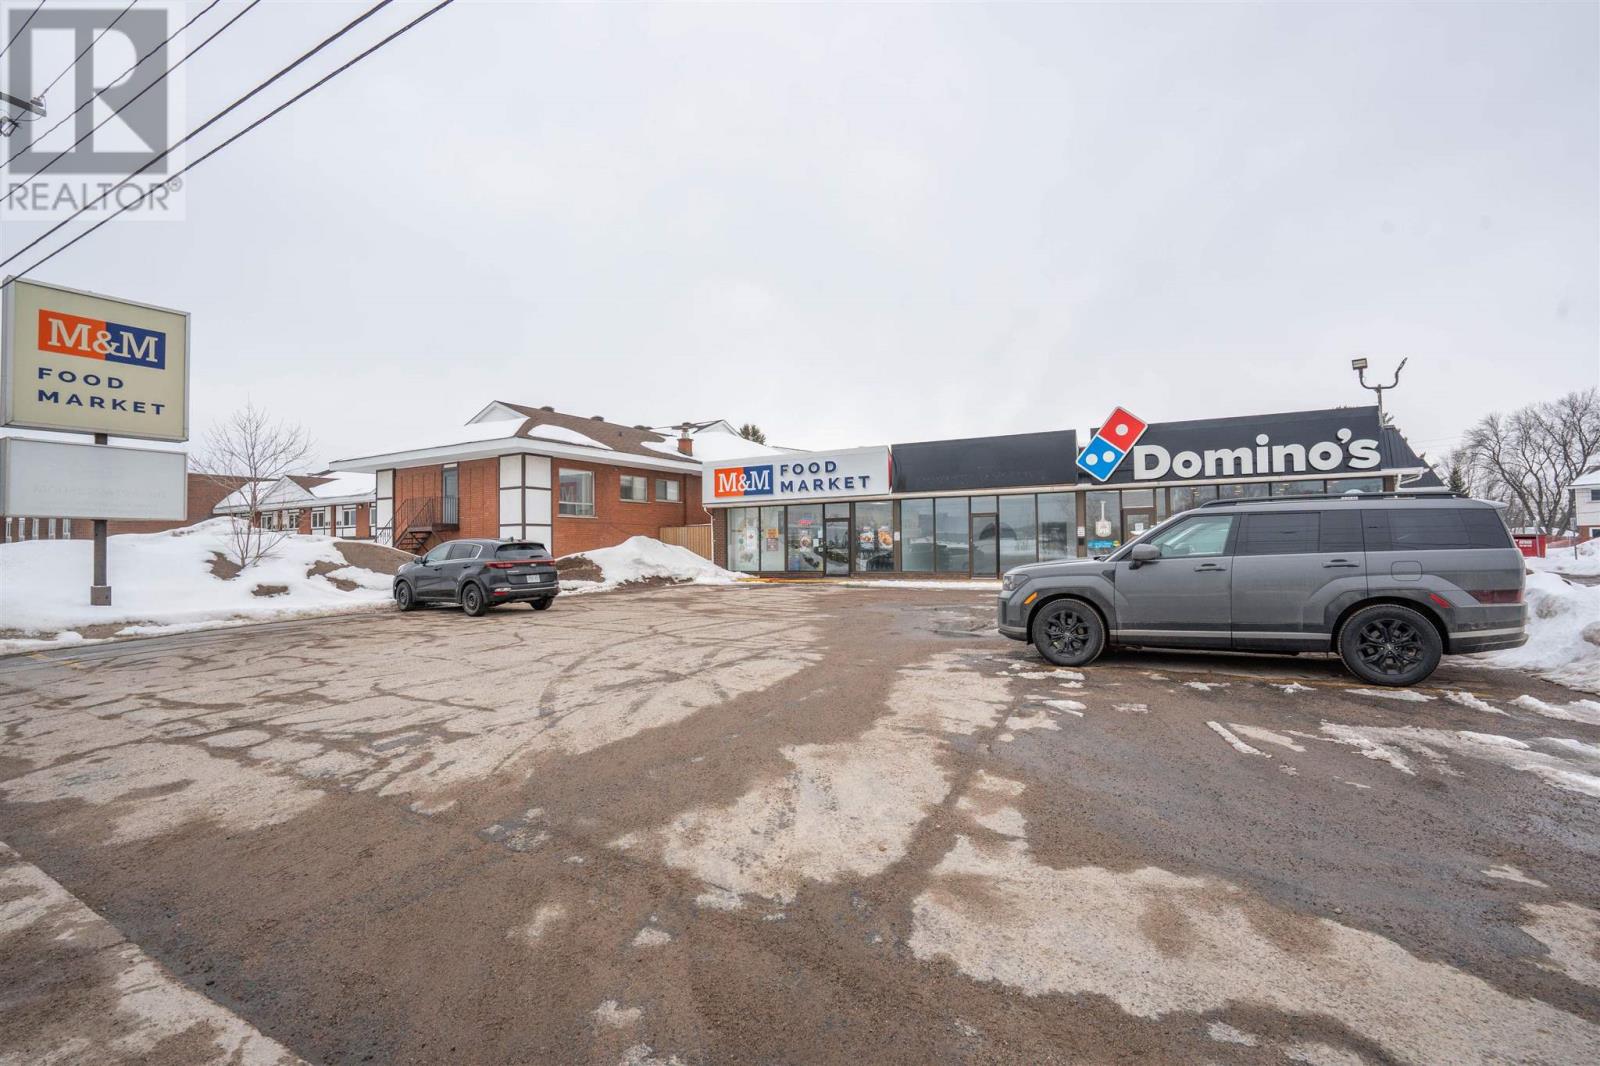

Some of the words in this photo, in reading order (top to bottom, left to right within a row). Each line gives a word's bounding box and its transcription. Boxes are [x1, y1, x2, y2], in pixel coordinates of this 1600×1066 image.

[47, 317, 159, 363] M&M
[38, 367, 124, 389] FOOD
[38, 390, 166, 415] MARKET
[1133, 428, 1381, 480] Domino's
[780, 461, 838, 476] FOOD
[718, 470, 771, 493] M&M
[780, 475, 871, 493] MARKET
